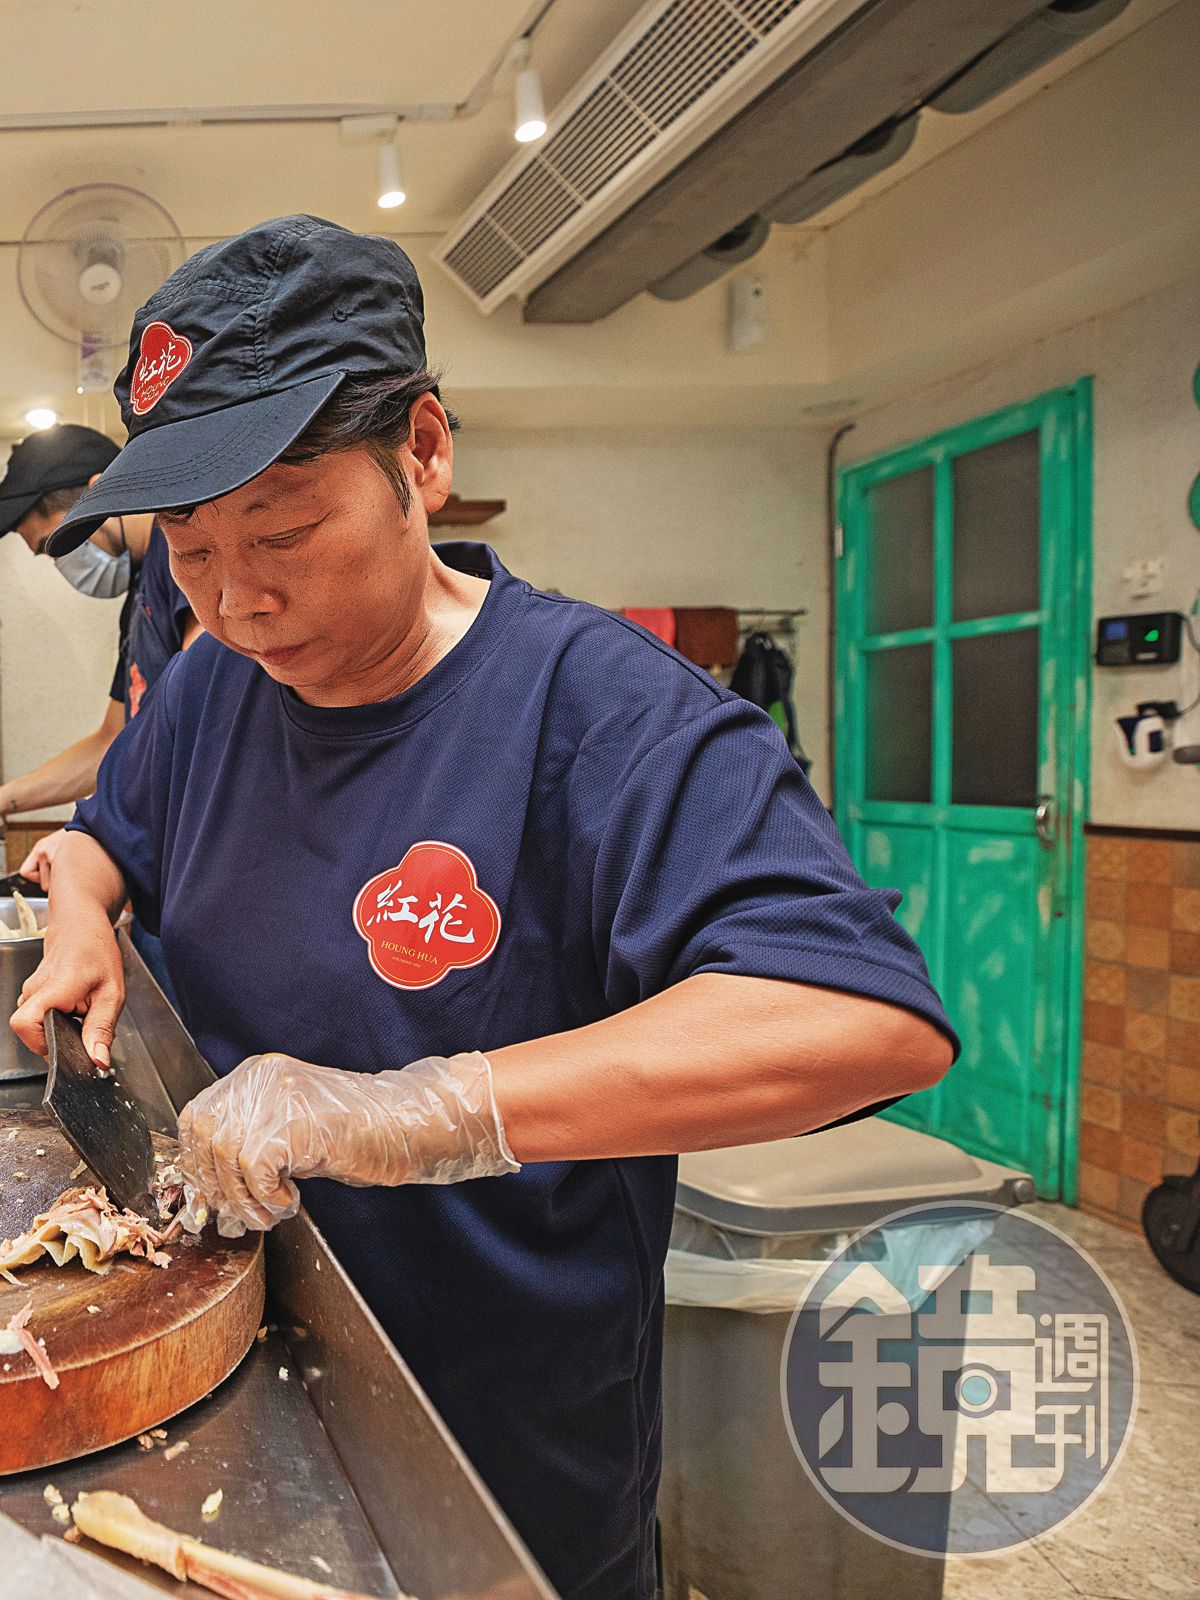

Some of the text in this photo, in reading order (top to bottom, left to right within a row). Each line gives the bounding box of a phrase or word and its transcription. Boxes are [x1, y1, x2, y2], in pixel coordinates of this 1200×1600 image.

[365, 879, 476, 944] 紅花
[381, 940, 416, 957] HOUNG
[417, 951, 438, 965] HUA
